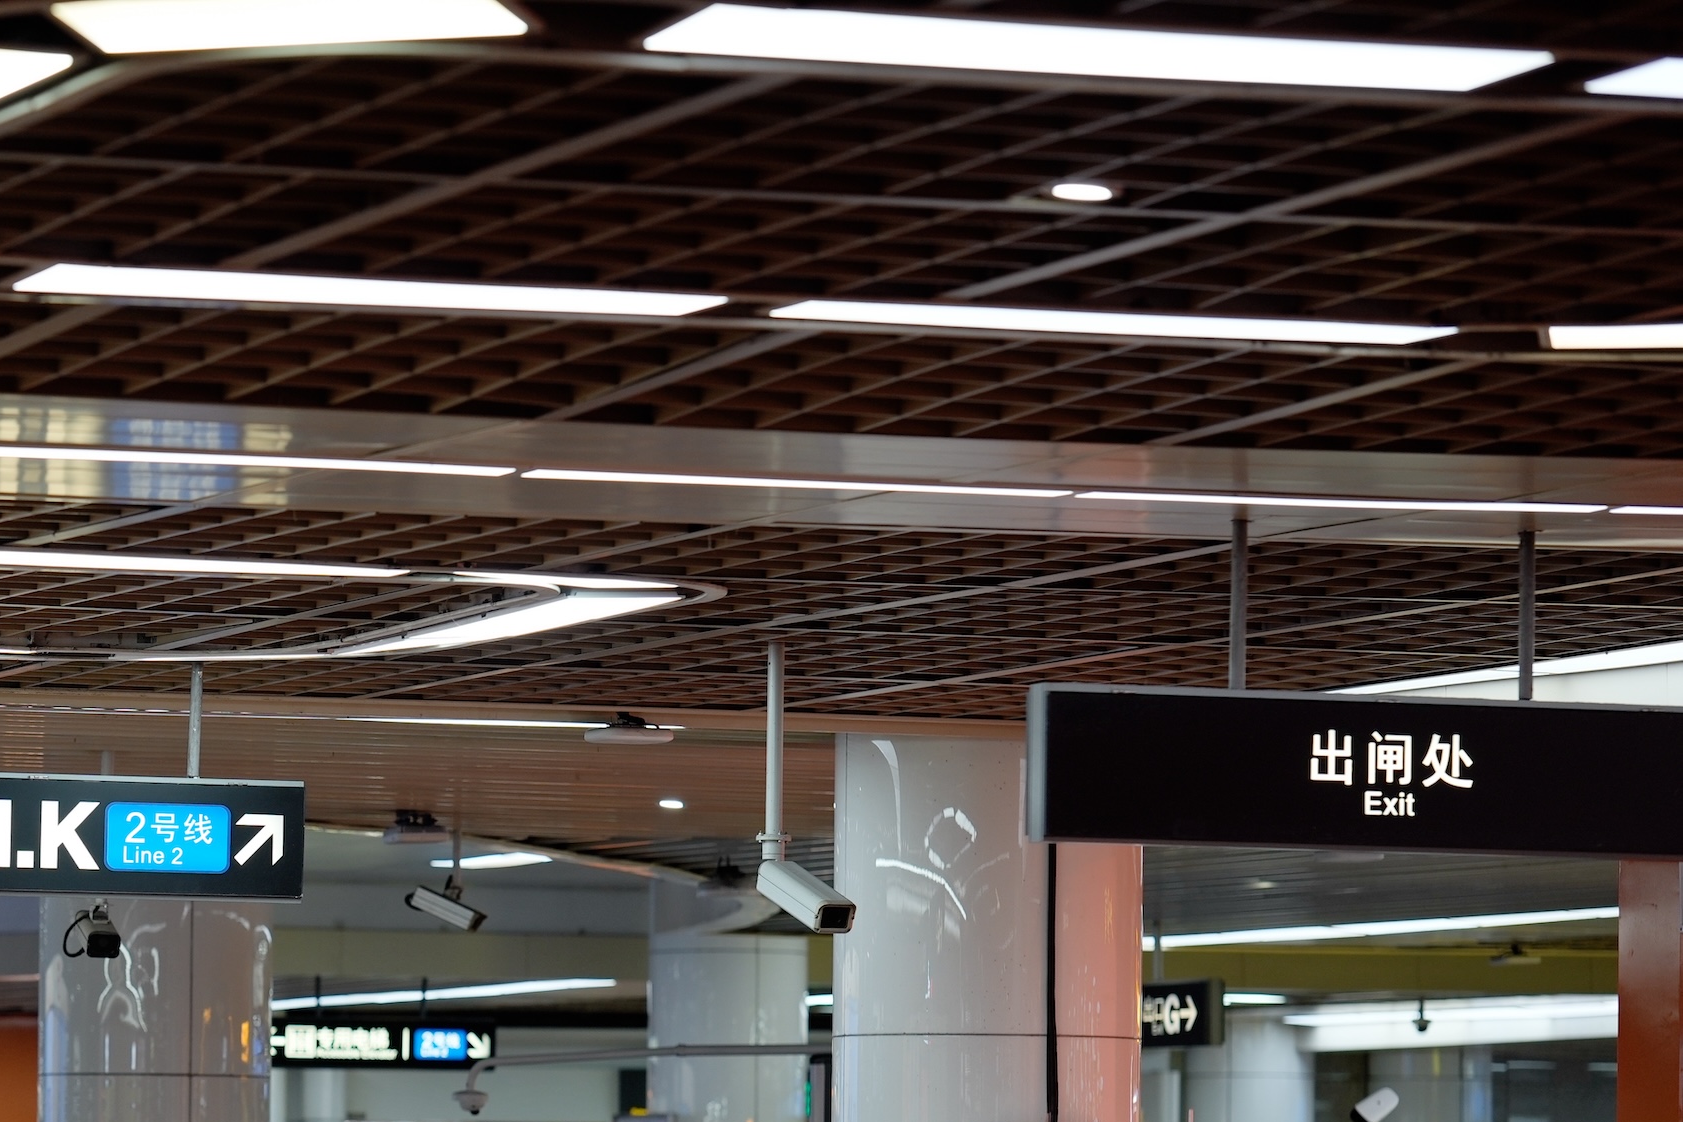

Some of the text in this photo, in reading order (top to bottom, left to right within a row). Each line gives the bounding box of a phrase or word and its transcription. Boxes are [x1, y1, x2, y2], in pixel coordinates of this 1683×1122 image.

[1309, 728, 1475, 789] 出闸处
[1363, 790, 1416, 817] Exit
[125, 811, 213, 845] 2号线
[122, 846, 184, 866] Line 2
[1163, 993, 1181, 1036] G
